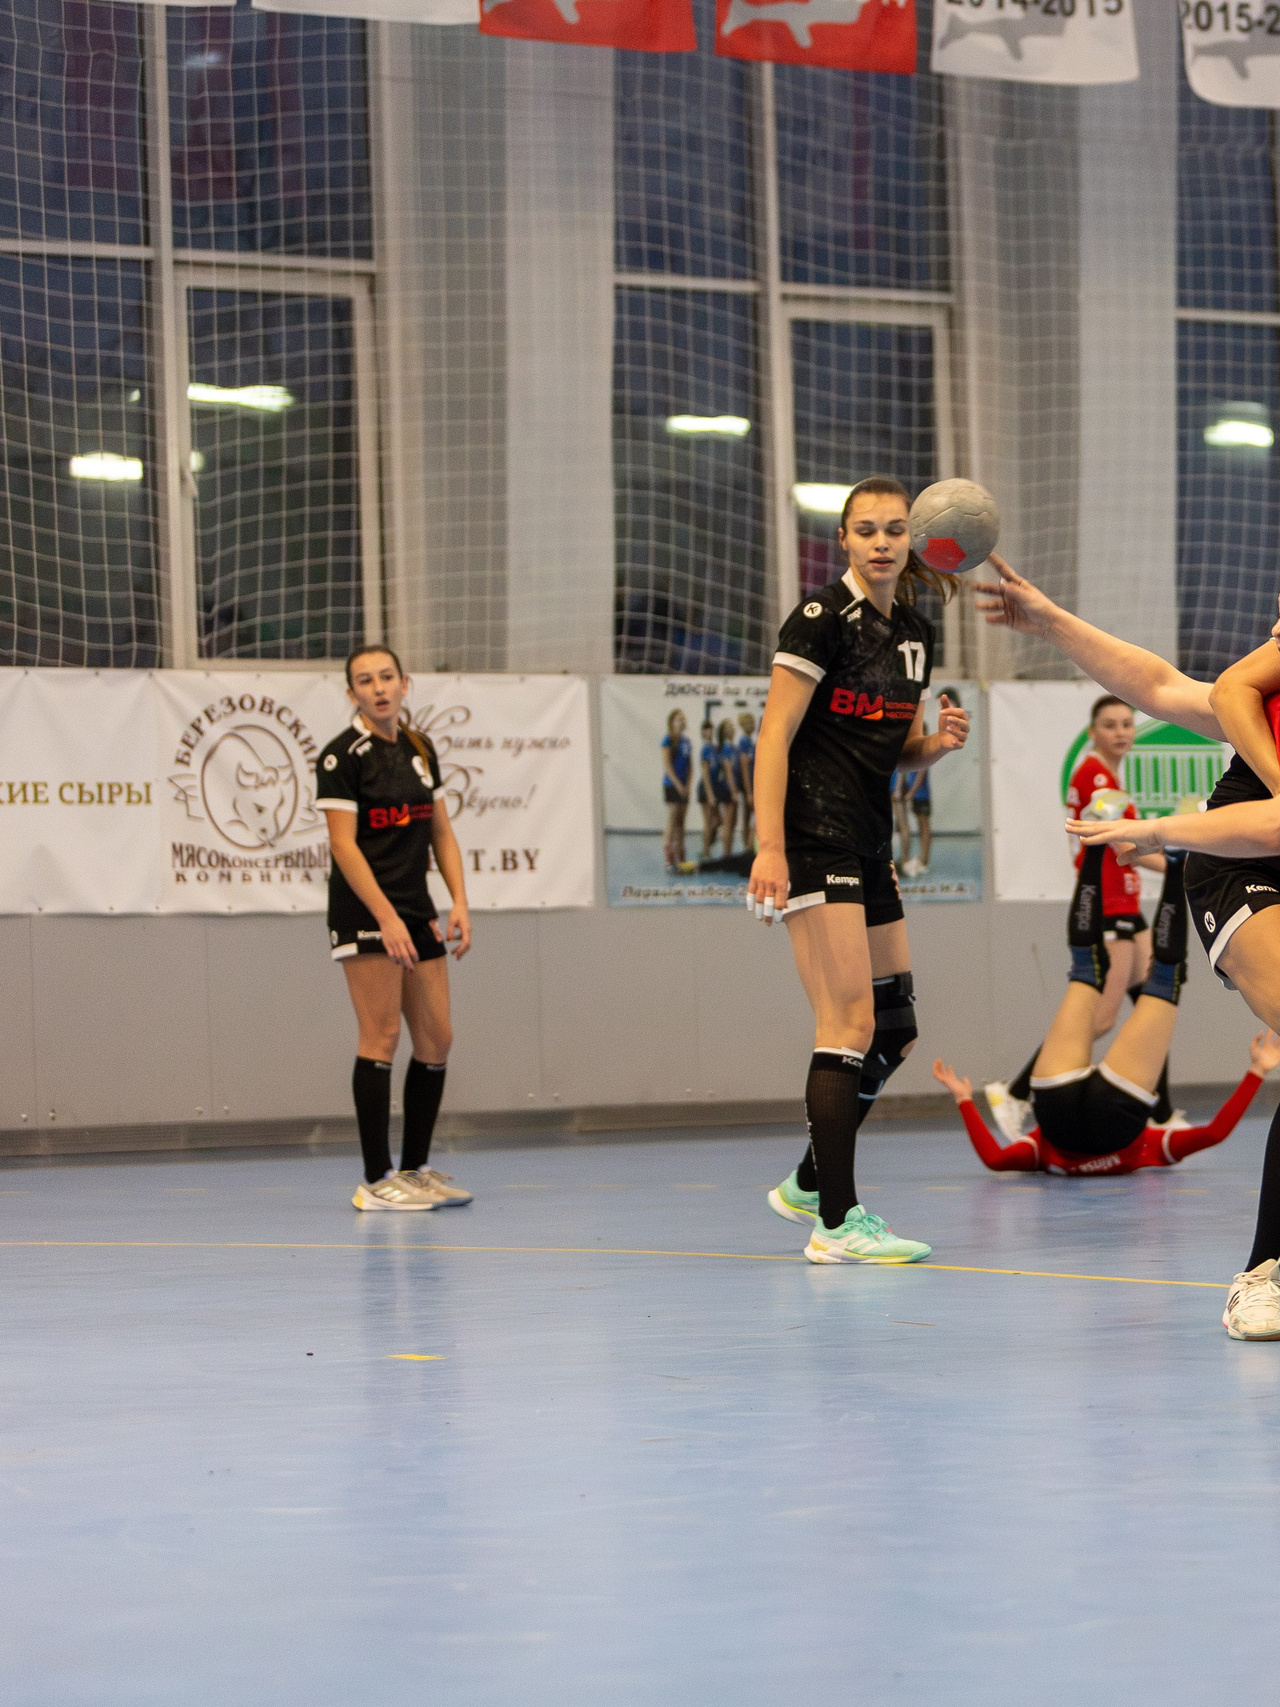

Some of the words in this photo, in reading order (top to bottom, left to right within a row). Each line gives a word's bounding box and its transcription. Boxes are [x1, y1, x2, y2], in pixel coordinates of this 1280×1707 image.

[897, 640, 925, 682] 17
[58, 781, 152, 806] СЫРЫ
[826, 873, 860, 886] Kempa
